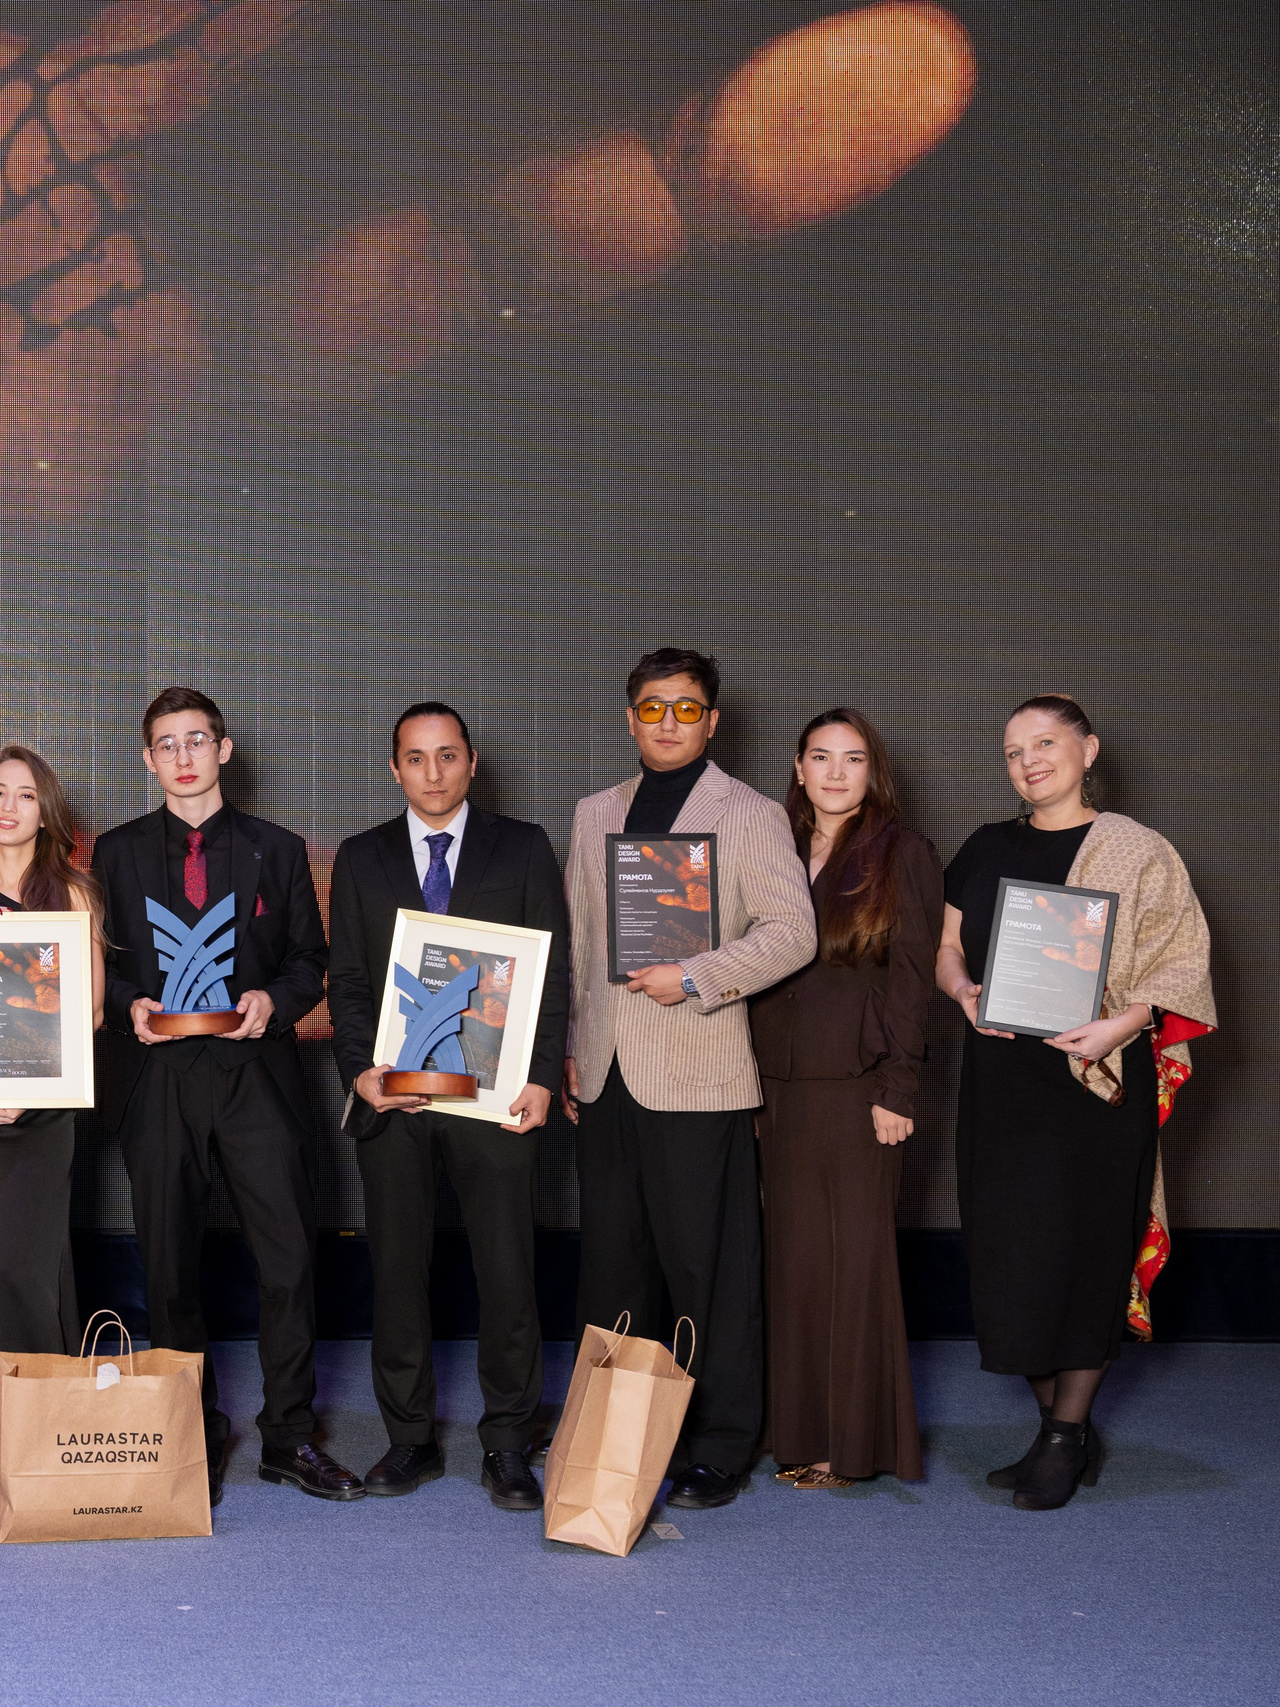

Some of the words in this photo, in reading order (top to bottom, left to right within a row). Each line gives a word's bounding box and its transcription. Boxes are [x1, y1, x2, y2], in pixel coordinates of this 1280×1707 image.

[1010, 896, 1033, 904] DESIGN
[1006, 920, 1042, 931] ГРАМОТА
[422, 978, 450, 987] ГРАМО
[56, 1432, 164, 1446] LAURASTAR
[61, 1450, 159, 1464] QAZAQSTAN
[73, 1506, 143, 1515] LAURASTAR.KZ
